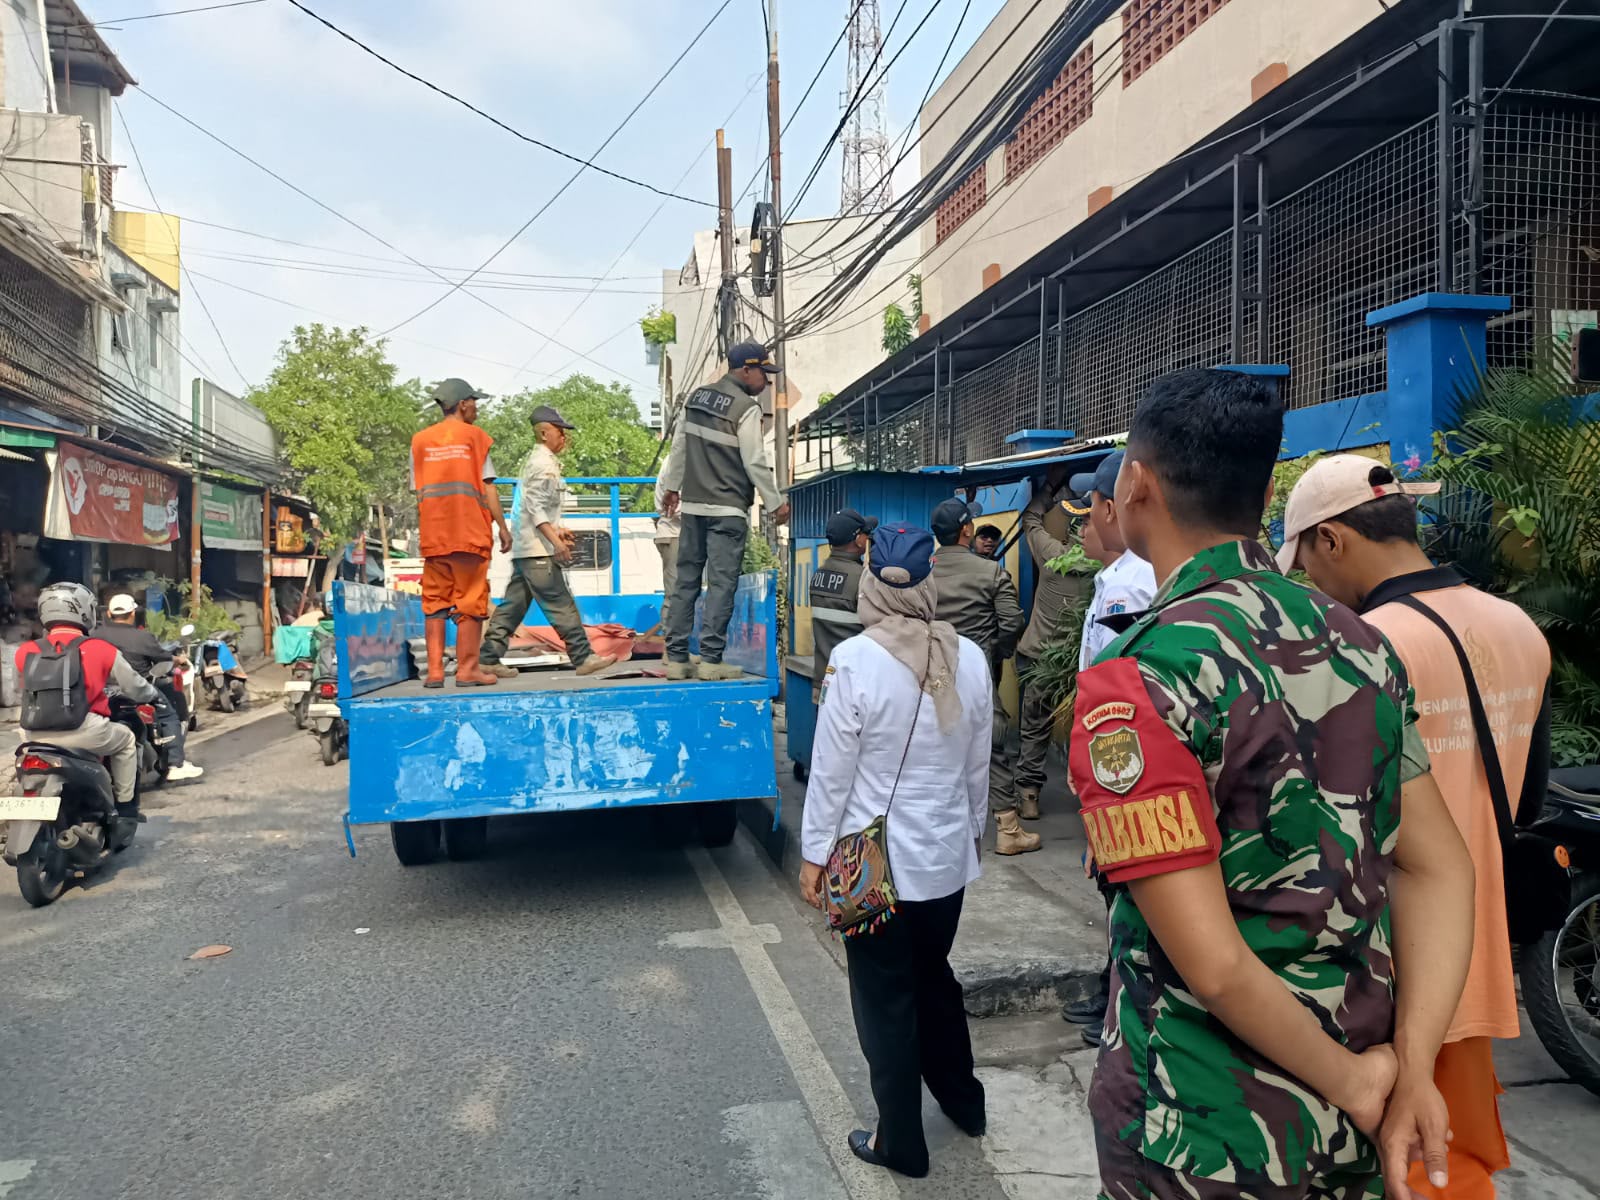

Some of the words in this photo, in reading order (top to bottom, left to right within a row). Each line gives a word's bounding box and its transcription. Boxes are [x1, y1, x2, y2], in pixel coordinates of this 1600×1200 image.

[692, 390, 711, 404] POL
[713, 394, 731, 411] PP
[827, 574, 844, 590] PP
[1083, 791, 1207, 866] BABINSA
